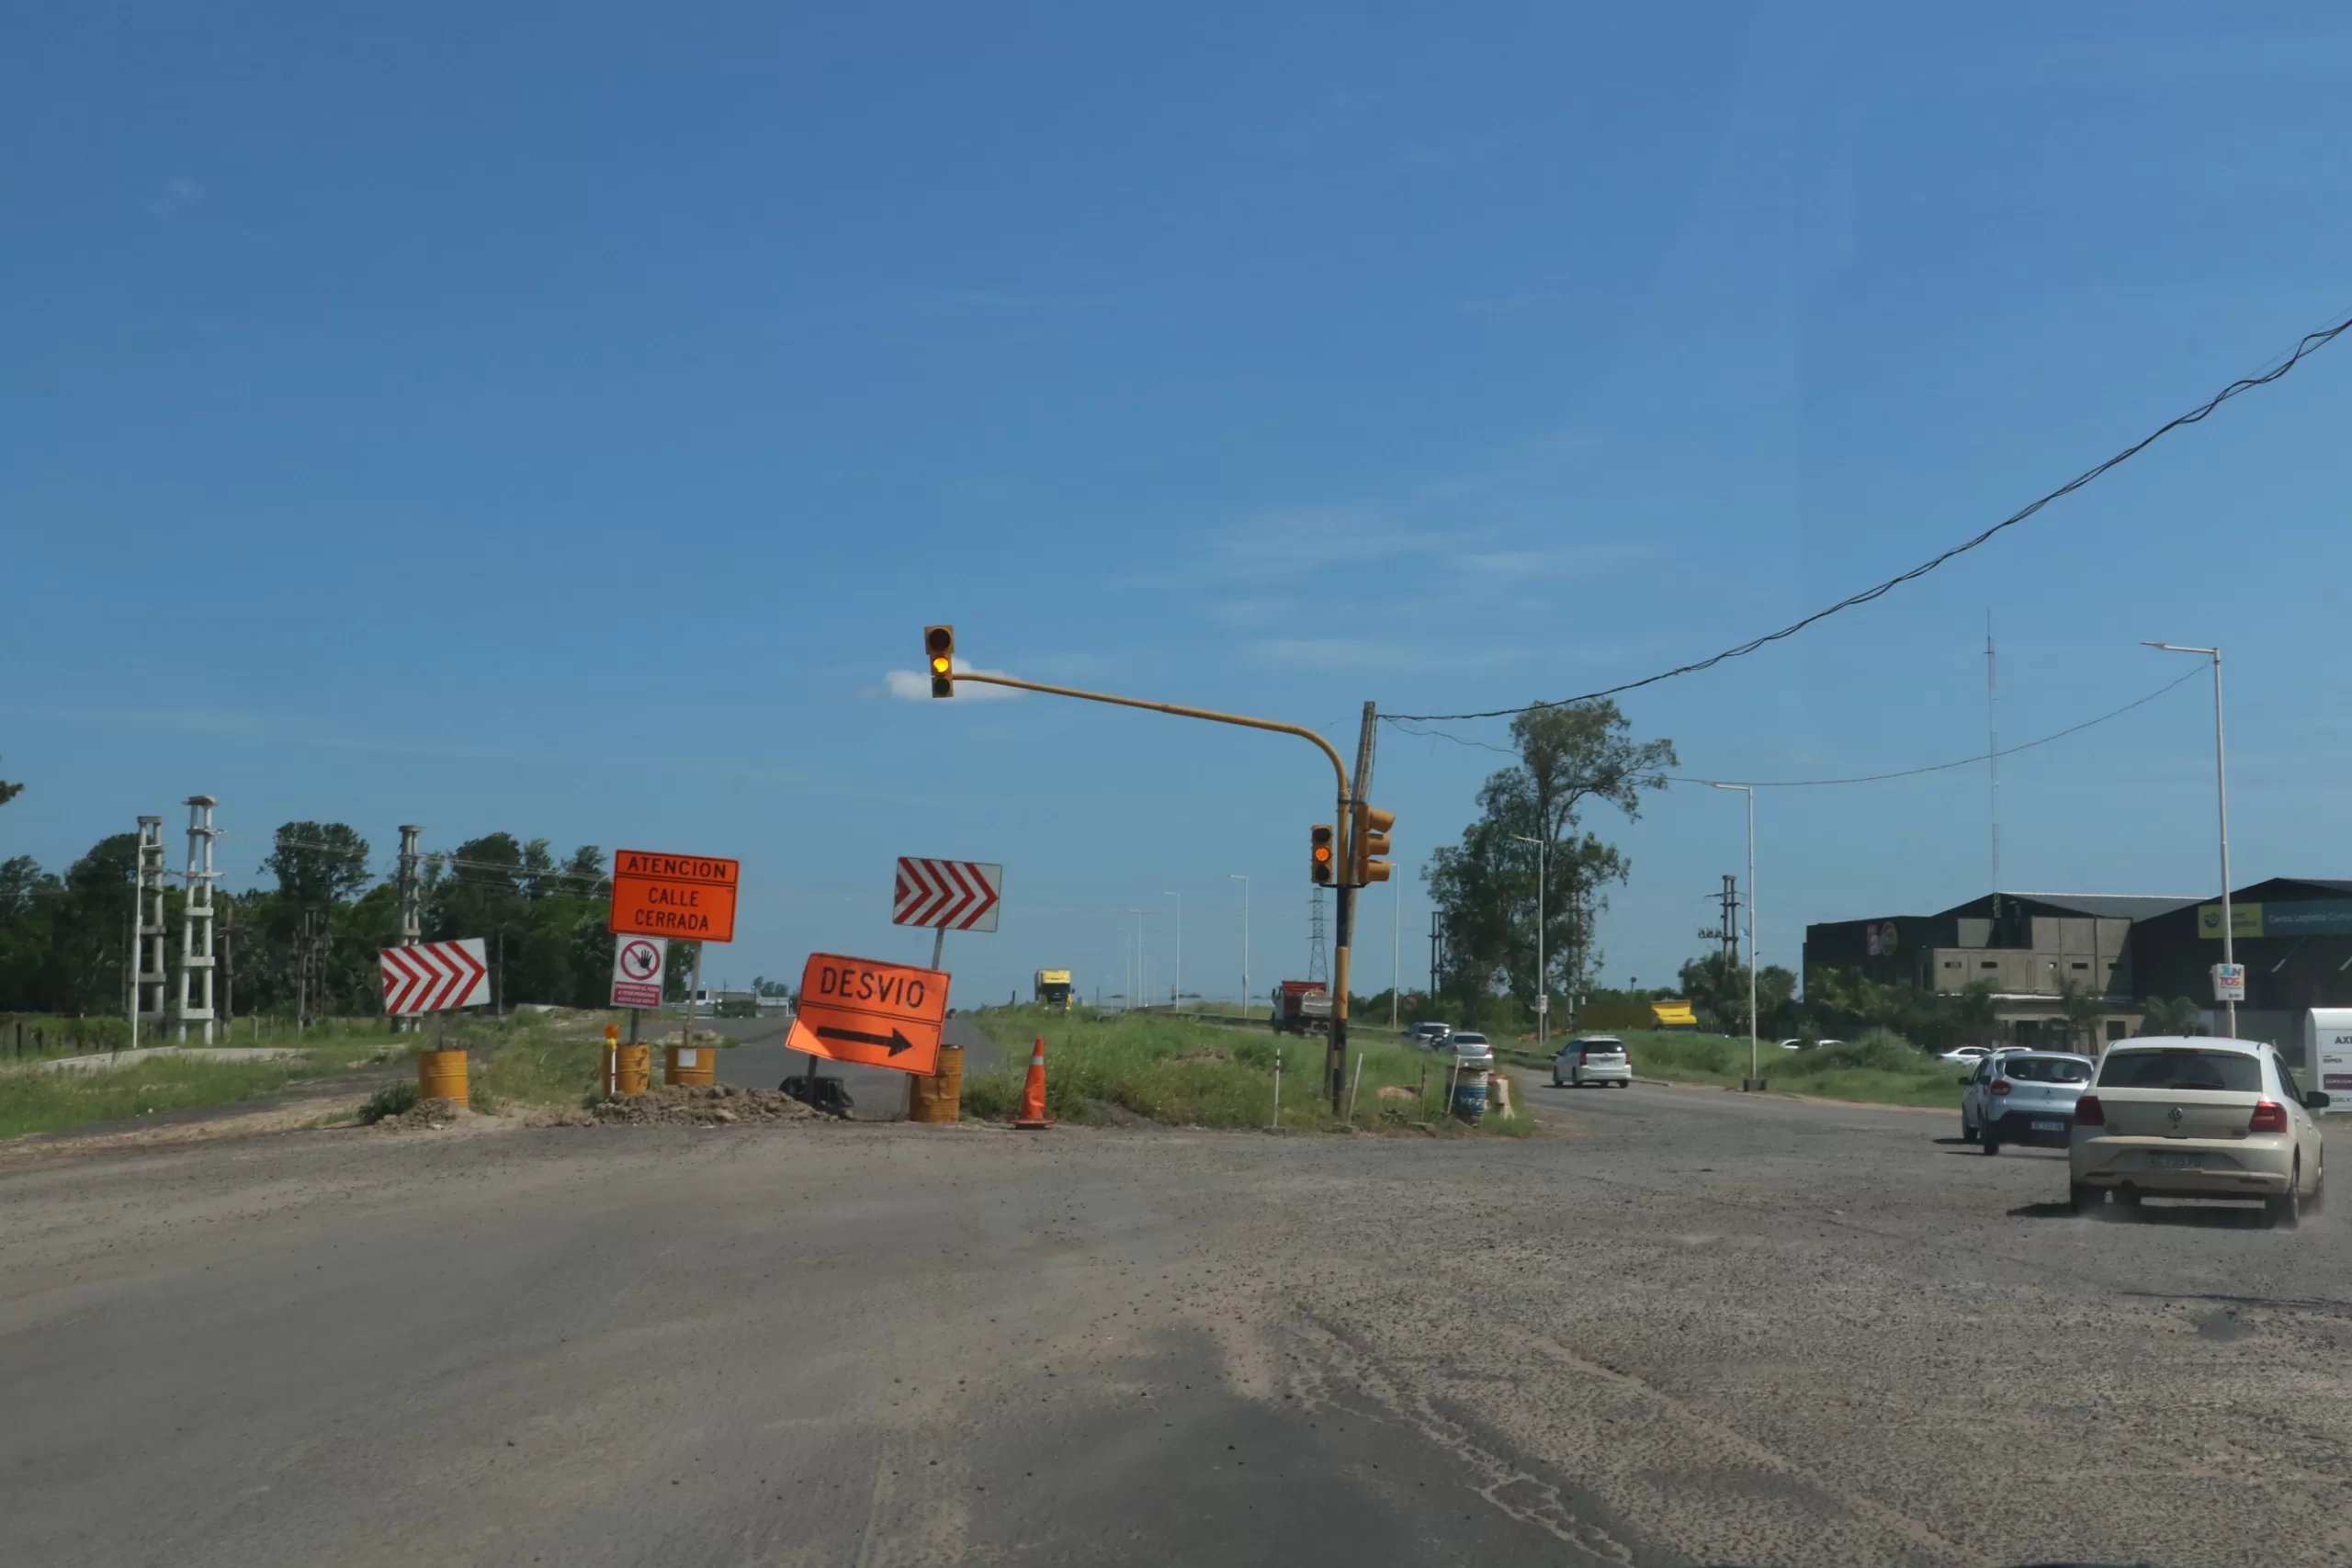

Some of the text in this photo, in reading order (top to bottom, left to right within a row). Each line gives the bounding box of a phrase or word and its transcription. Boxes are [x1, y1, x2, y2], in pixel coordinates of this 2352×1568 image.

[628, 856, 727, 878] ATENCION
[649, 887, 699, 907] CALLE
[635, 909, 709, 931] CERRADA
[820, 966, 925, 1008] DESVIO
